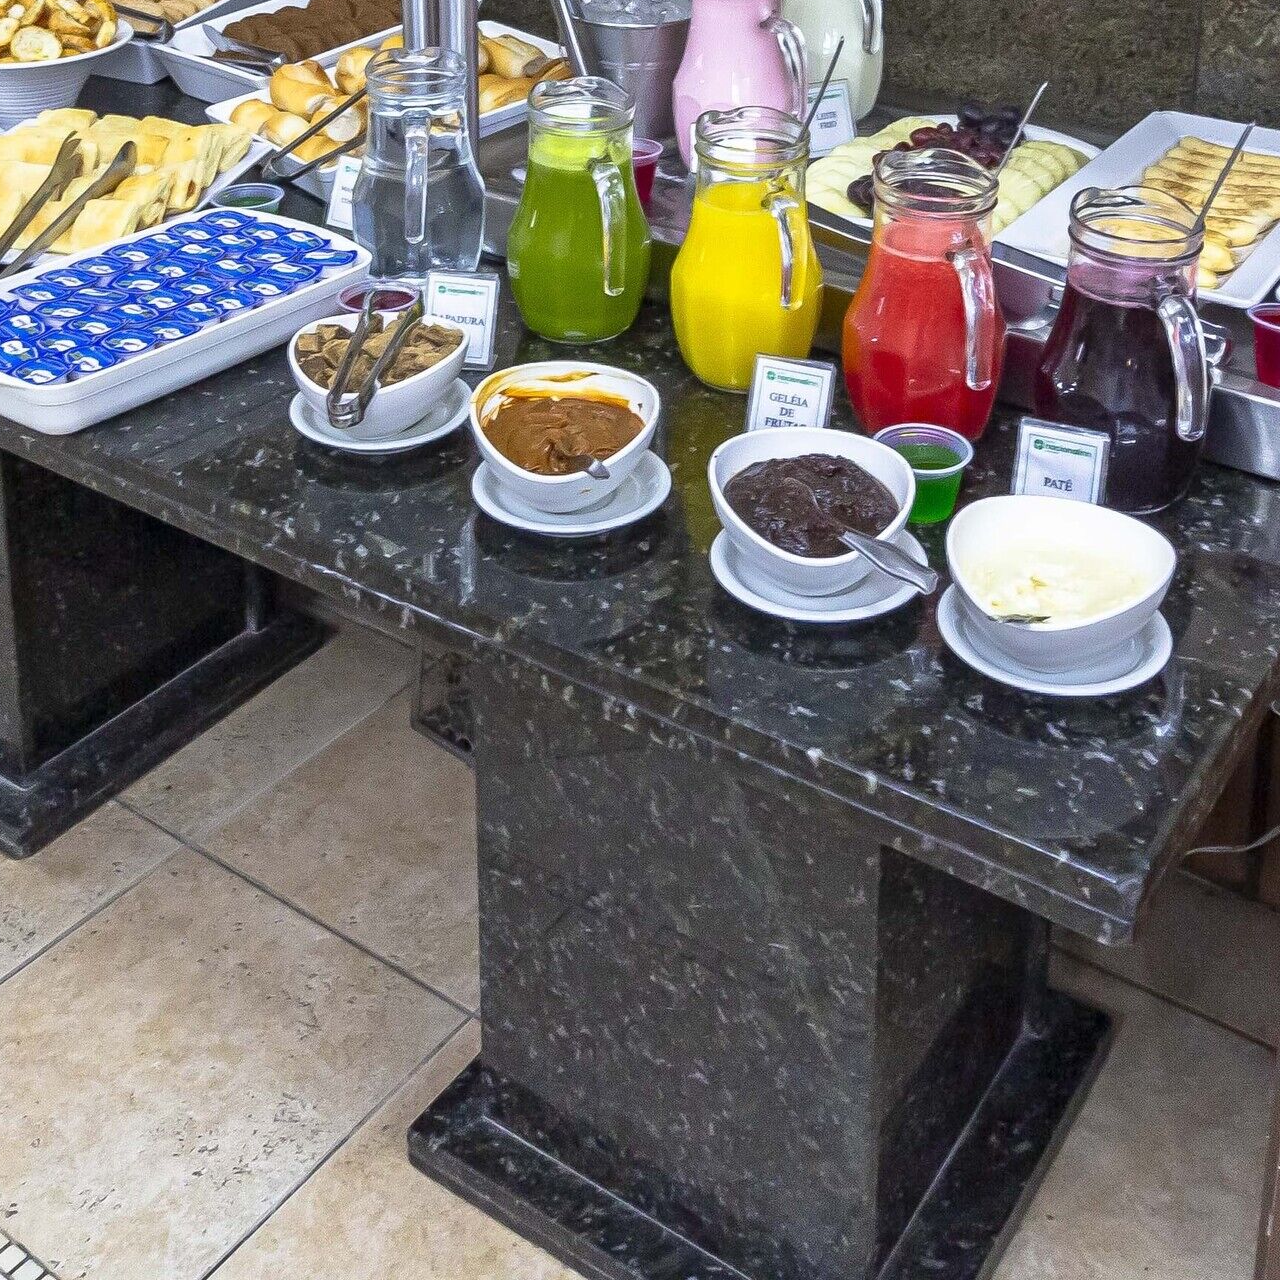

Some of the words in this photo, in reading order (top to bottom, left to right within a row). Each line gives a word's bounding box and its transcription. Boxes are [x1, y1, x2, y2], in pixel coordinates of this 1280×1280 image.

[431, 313, 485, 326] PADURA
[769, 392, 808, 408] GELÉIA
[780, 407, 795, 418] DE
[764, 417, 807, 427] FRUT
[1043, 477, 1073, 492] PATÉ
